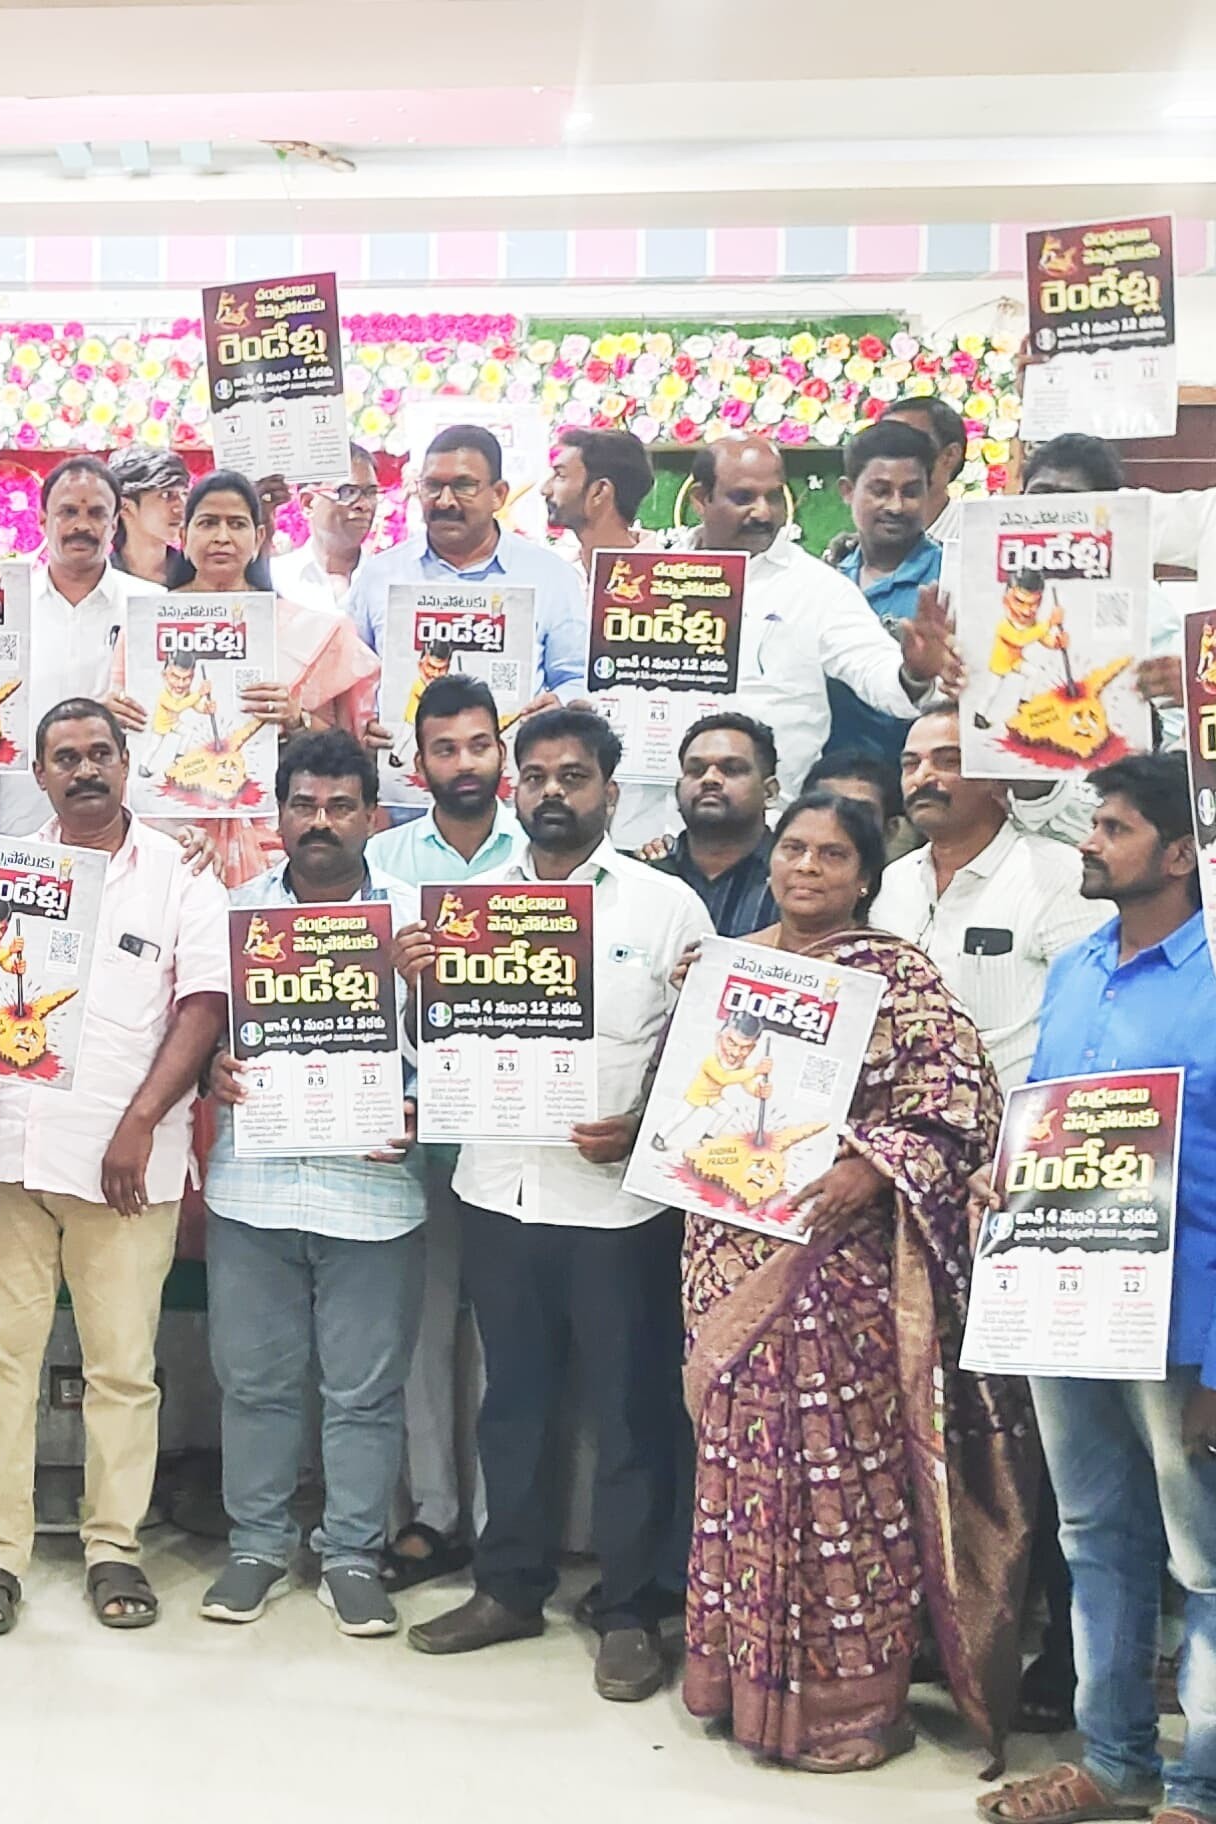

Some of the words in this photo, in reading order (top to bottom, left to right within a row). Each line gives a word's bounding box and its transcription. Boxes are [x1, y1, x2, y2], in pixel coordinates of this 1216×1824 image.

[1040, 267, 1161, 315] రెండేళ్లు
[217, 322, 328, 365] రెండేళ్లు
[1001, 533, 1109, 579] రెండేళ్లు
[418, 614, 502, 650] రెండేళ్లు
[604, 603, 726, 655] రెండేళ్లు
[159, 623, 244, 658] రెండేళ్లు
[488, 895, 567, 913] చంద్రబాబు
[293, 915, 366, 933] చంద్రబాబు
[436, 940, 576, 997] రెండేళ్లు
[246, 958, 379, 1011] రెండేళ్లు
[482, 1001, 493, 1014] 4
[529, 1001, 549, 1015] 12
[725, 981, 830, 1043] రెండేళ్లు
[292, 1019, 301, 1031] 4
[337, 1018, 354, 1030] 12
[444, 1061, 451, 1071] 4
[555, 1064, 570, 1073] 12
[256, 1078, 264, 1088] 4
[362, 1075, 376, 1085] 12
[1067, 1087, 1149, 1109] చంద్రబాబు
[1005, 1137, 1155, 1202] రెండేళ్లు
[1046, 1209, 1057, 1223] 4
[1099, 1209, 1120, 1224] 12
[999, 1279, 1008, 1291] 4
[1123, 1281, 1140, 1293] 12
